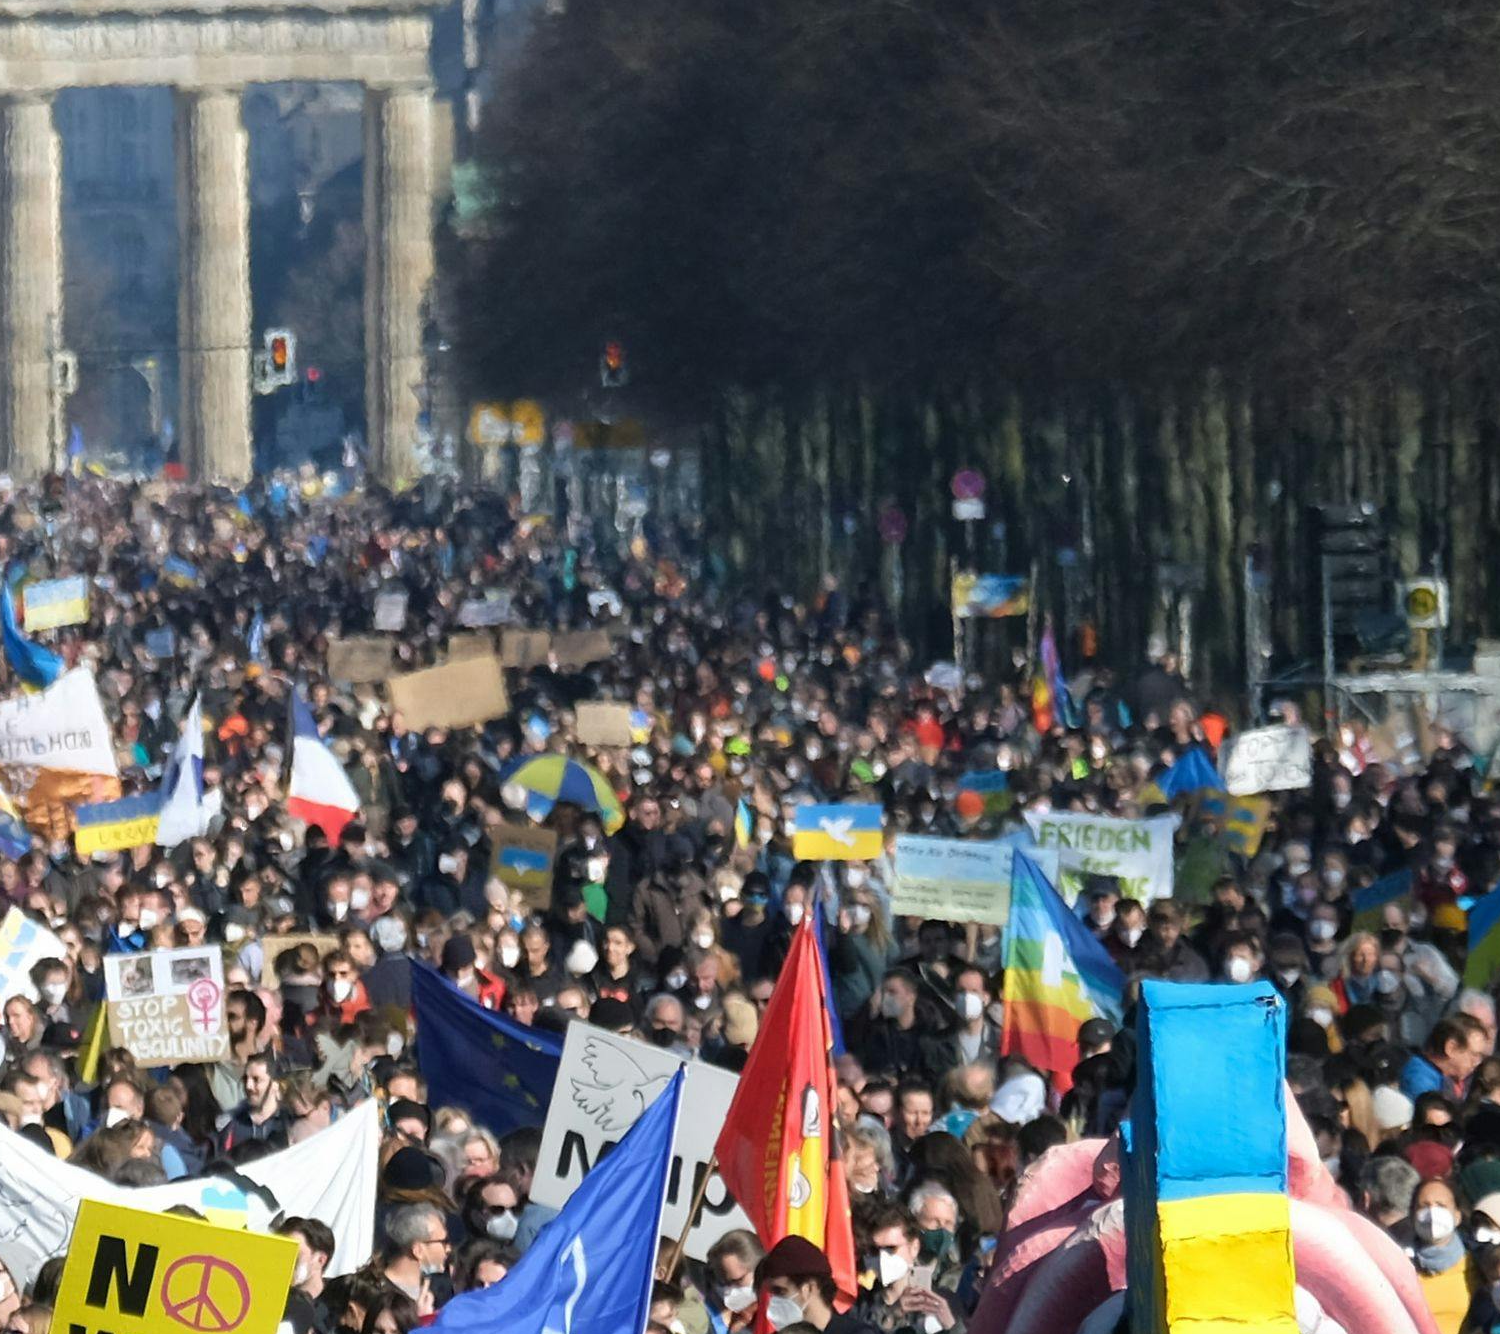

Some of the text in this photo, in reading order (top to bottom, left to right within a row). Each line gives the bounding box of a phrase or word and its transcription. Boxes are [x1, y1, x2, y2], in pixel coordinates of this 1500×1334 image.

[1039, 822, 1152, 853] FRIEDEN
[116, 995, 178, 1019] STOP
[117, 1019, 184, 1038] TOXIC
